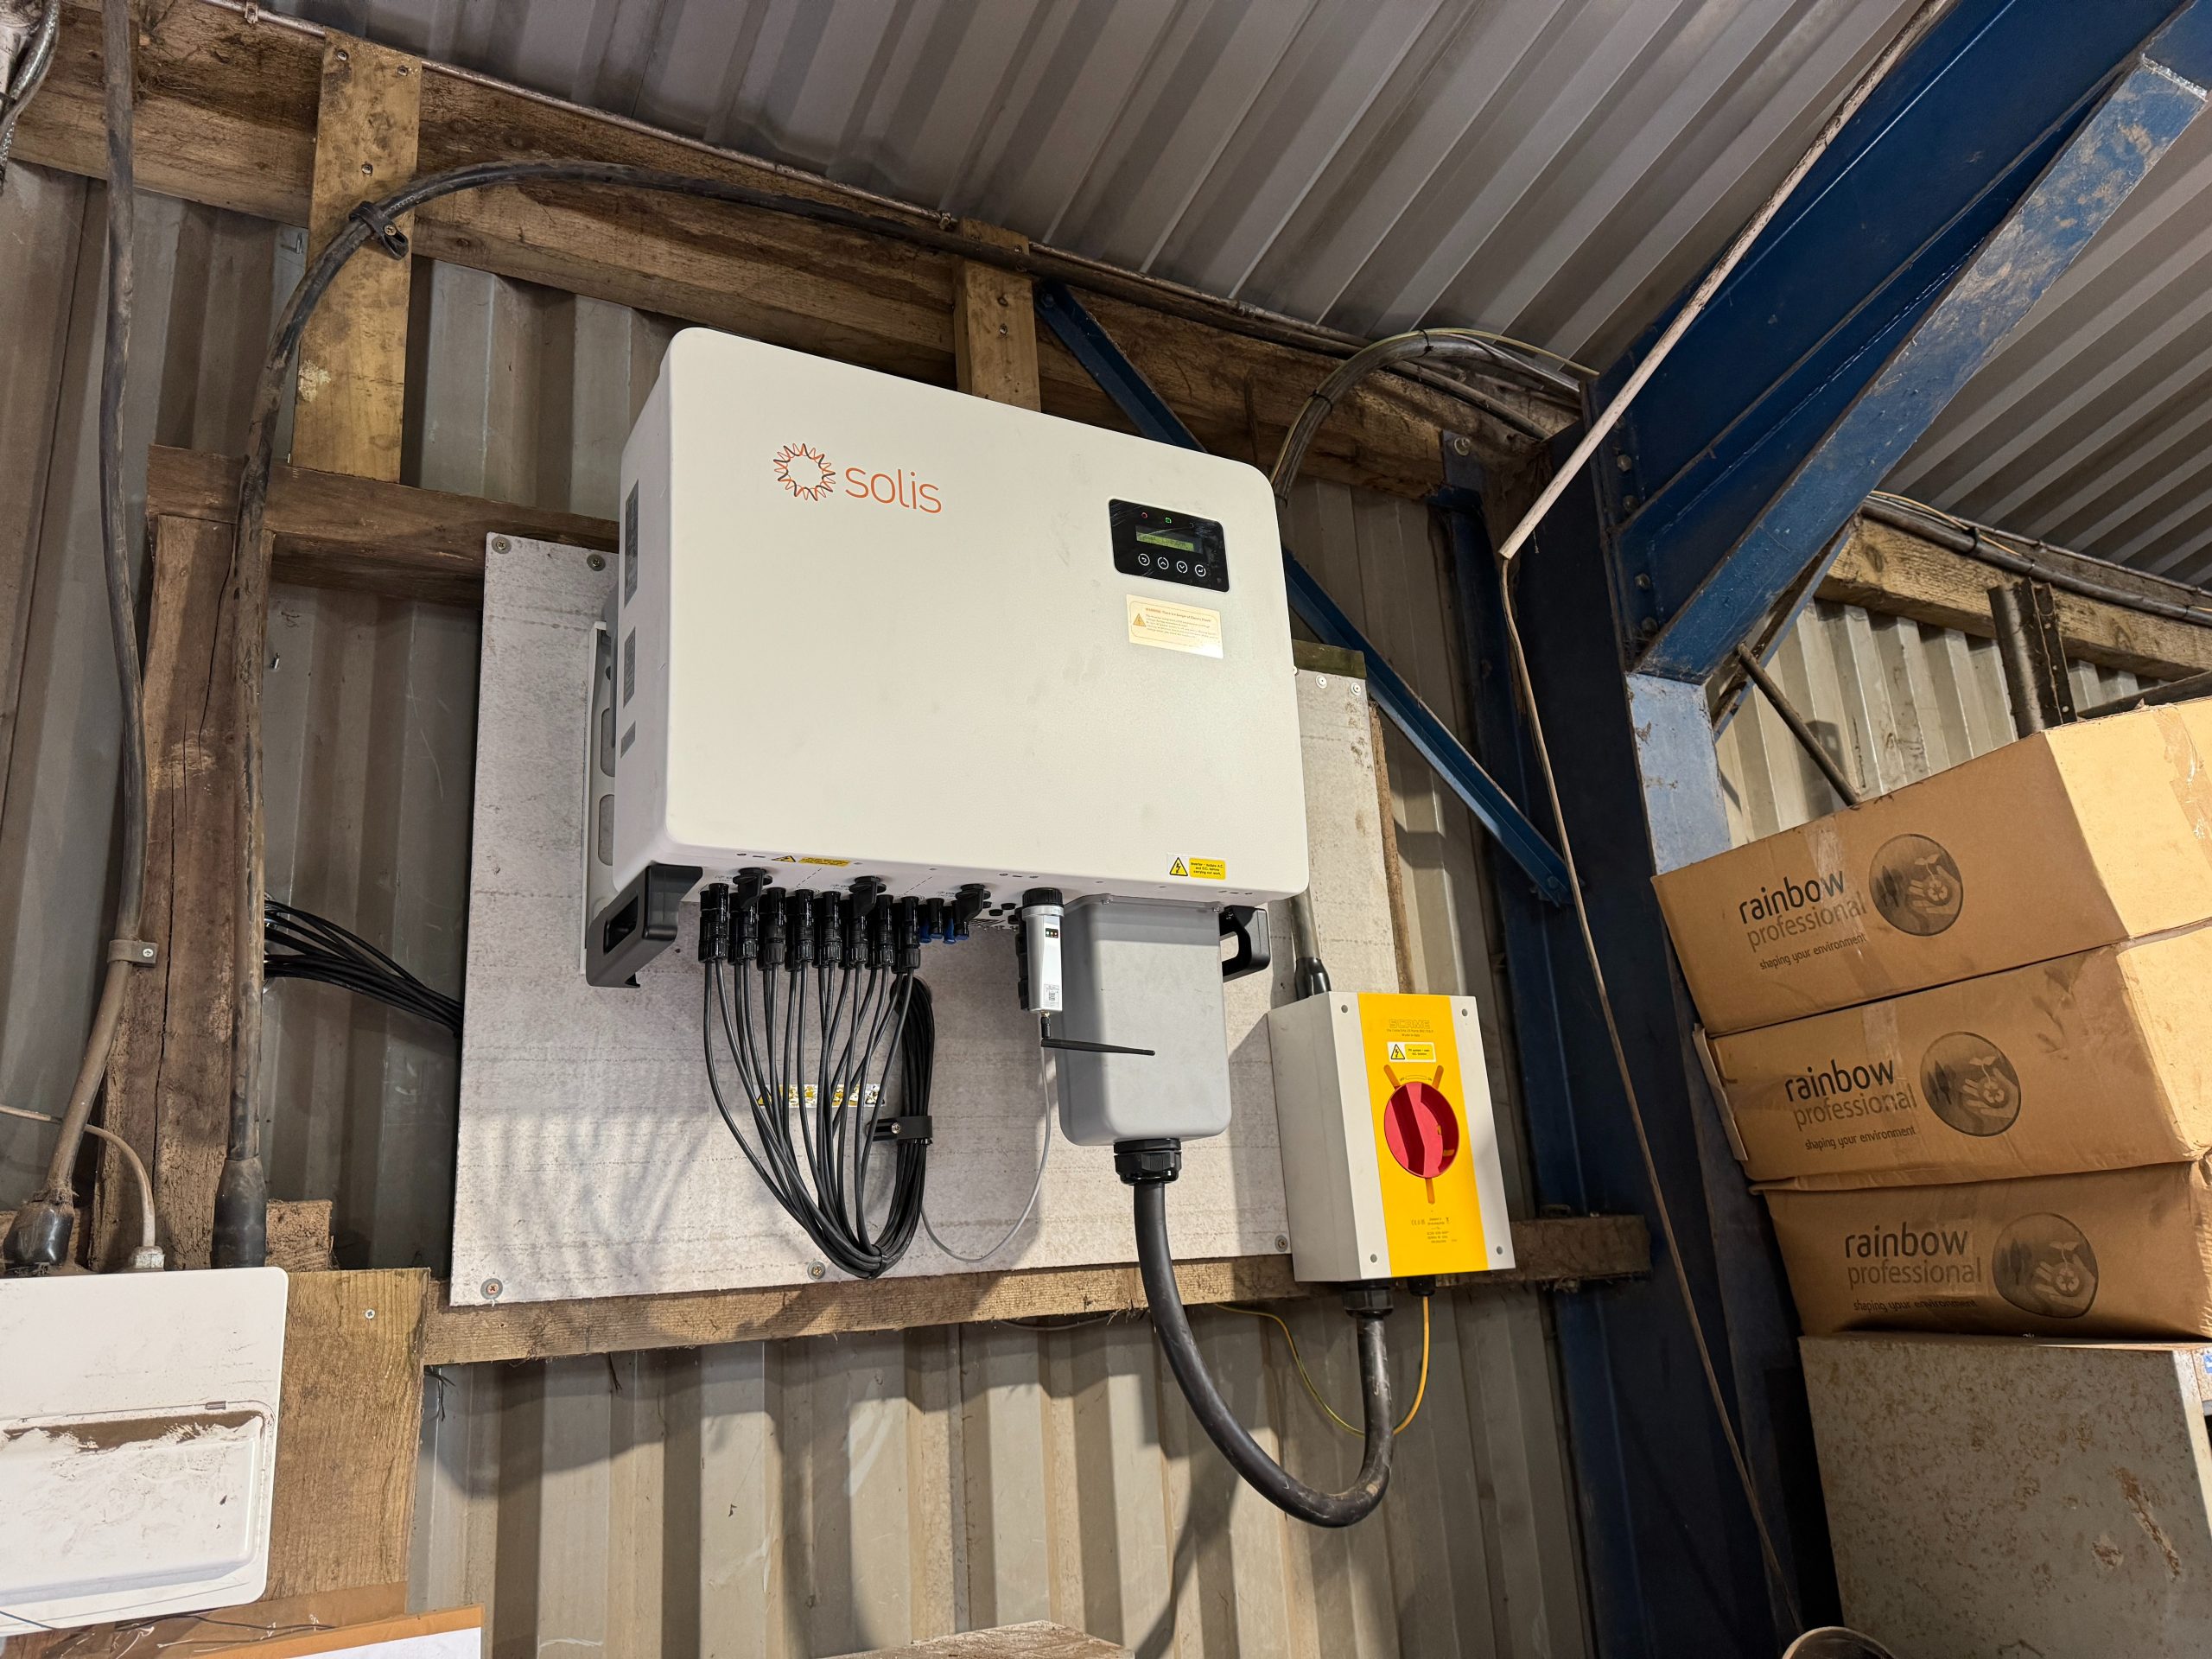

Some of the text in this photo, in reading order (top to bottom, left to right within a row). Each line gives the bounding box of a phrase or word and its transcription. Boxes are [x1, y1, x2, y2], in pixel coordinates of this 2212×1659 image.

[845, 467, 942, 514] solis
[1738, 870, 1844, 924] rainbow
[1747, 890, 1866, 953] professional
[1759, 933, 1867, 969] shaping your environment
[1784, 1058, 1894, 1102] rainbow
[1793, 1083, 1917, 1132] professional
[1805, 1125, 1916, 1151] shaping your environment
[1845, 1222, 1968, 1258] rainbow
[1847, 1256, 1981, 1290] professional
[1853, 1299, 1978, 1313] shaping your environment
